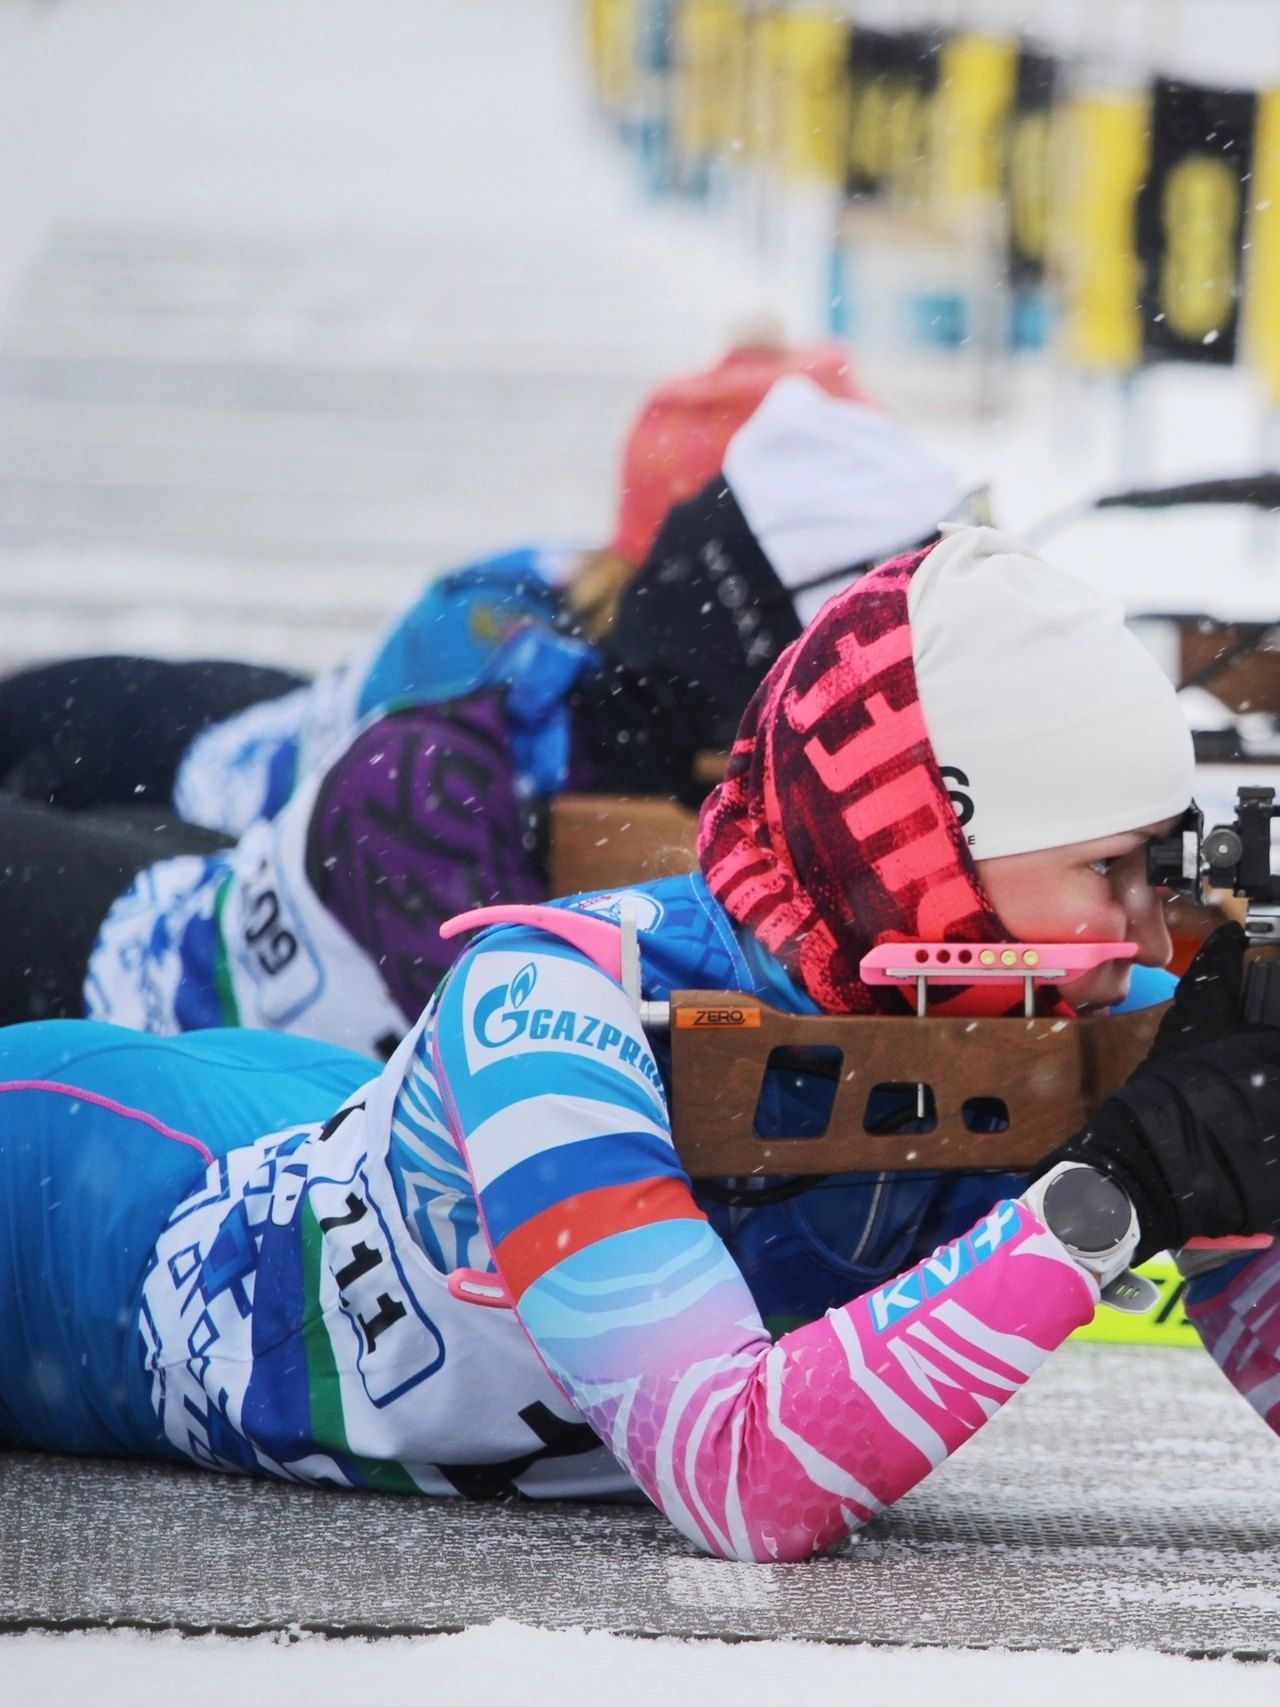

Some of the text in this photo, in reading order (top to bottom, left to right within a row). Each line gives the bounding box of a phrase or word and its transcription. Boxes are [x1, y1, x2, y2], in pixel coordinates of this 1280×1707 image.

[528, 1007, 667, 1103] GAZPRO
[692, 1009, 747, 1027] ZERO
[318, 1191, 408, 1356] 111
